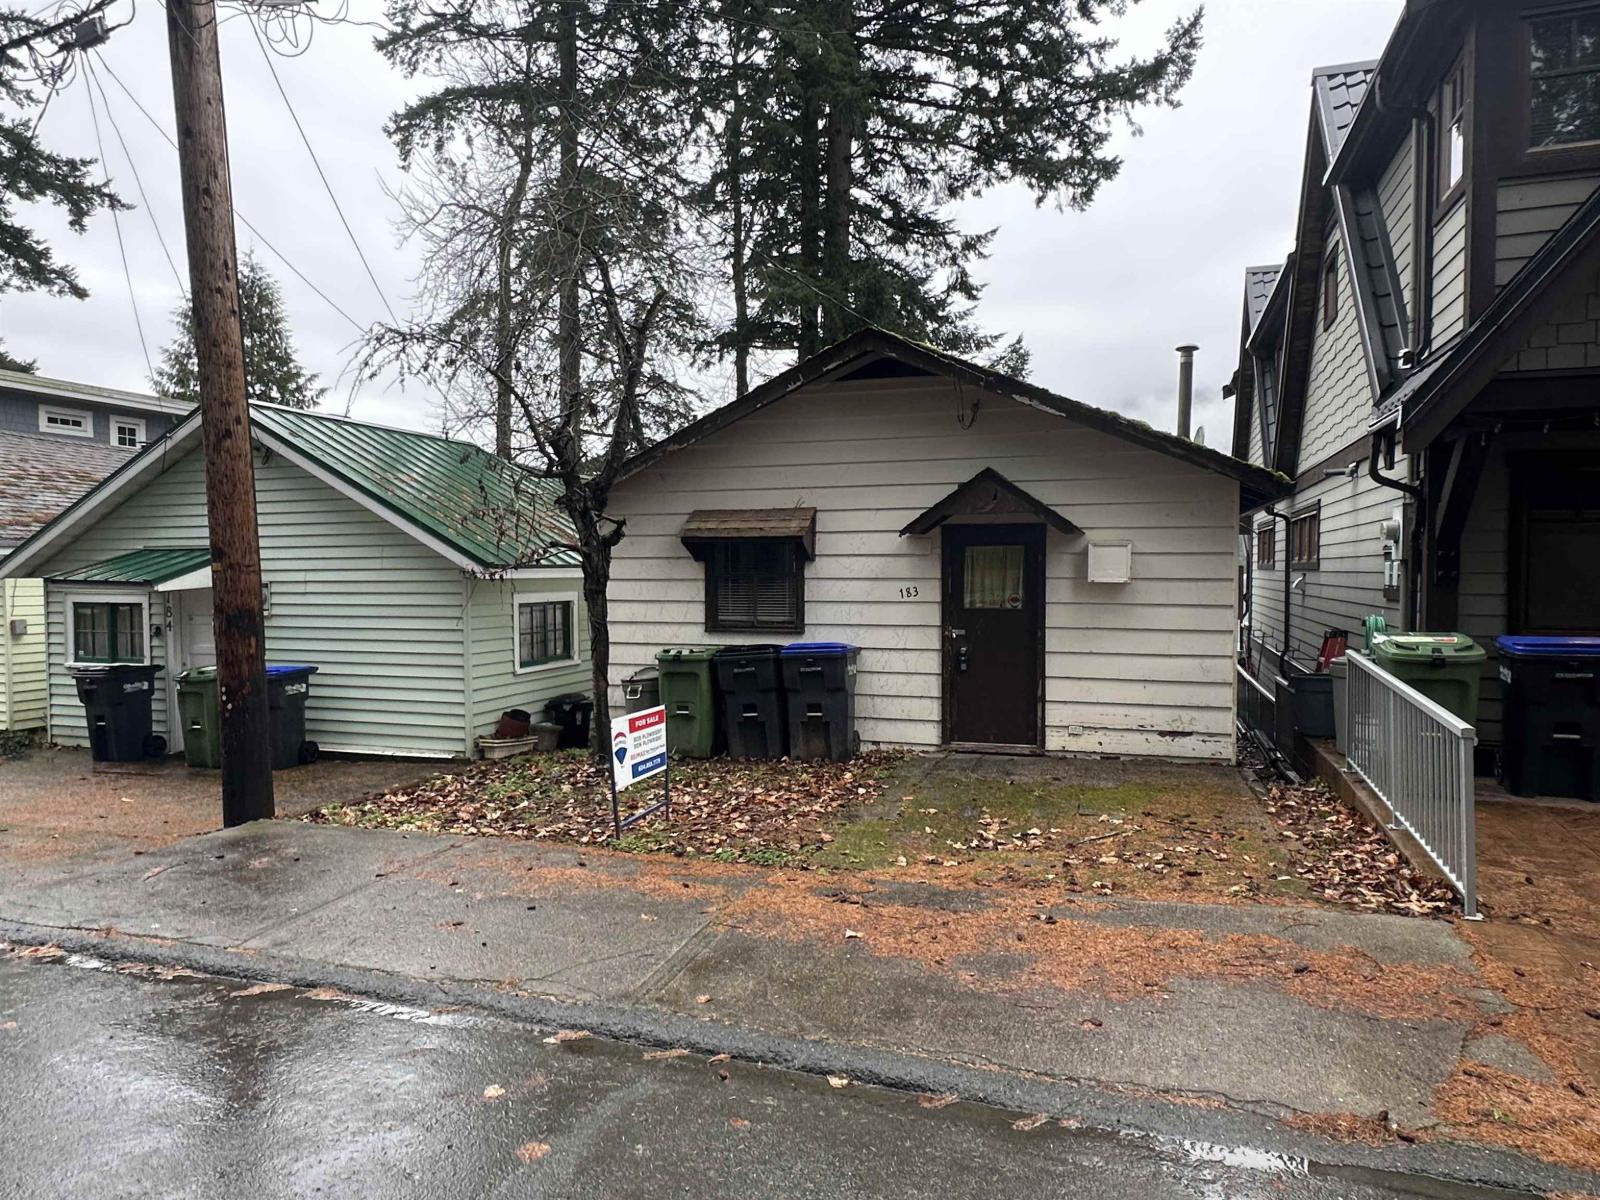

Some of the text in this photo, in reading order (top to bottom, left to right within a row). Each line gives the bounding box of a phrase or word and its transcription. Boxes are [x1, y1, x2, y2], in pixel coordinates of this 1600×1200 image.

[899, 586, 919, 599] 183
[635, 715, 659, 728] FOR SALE
